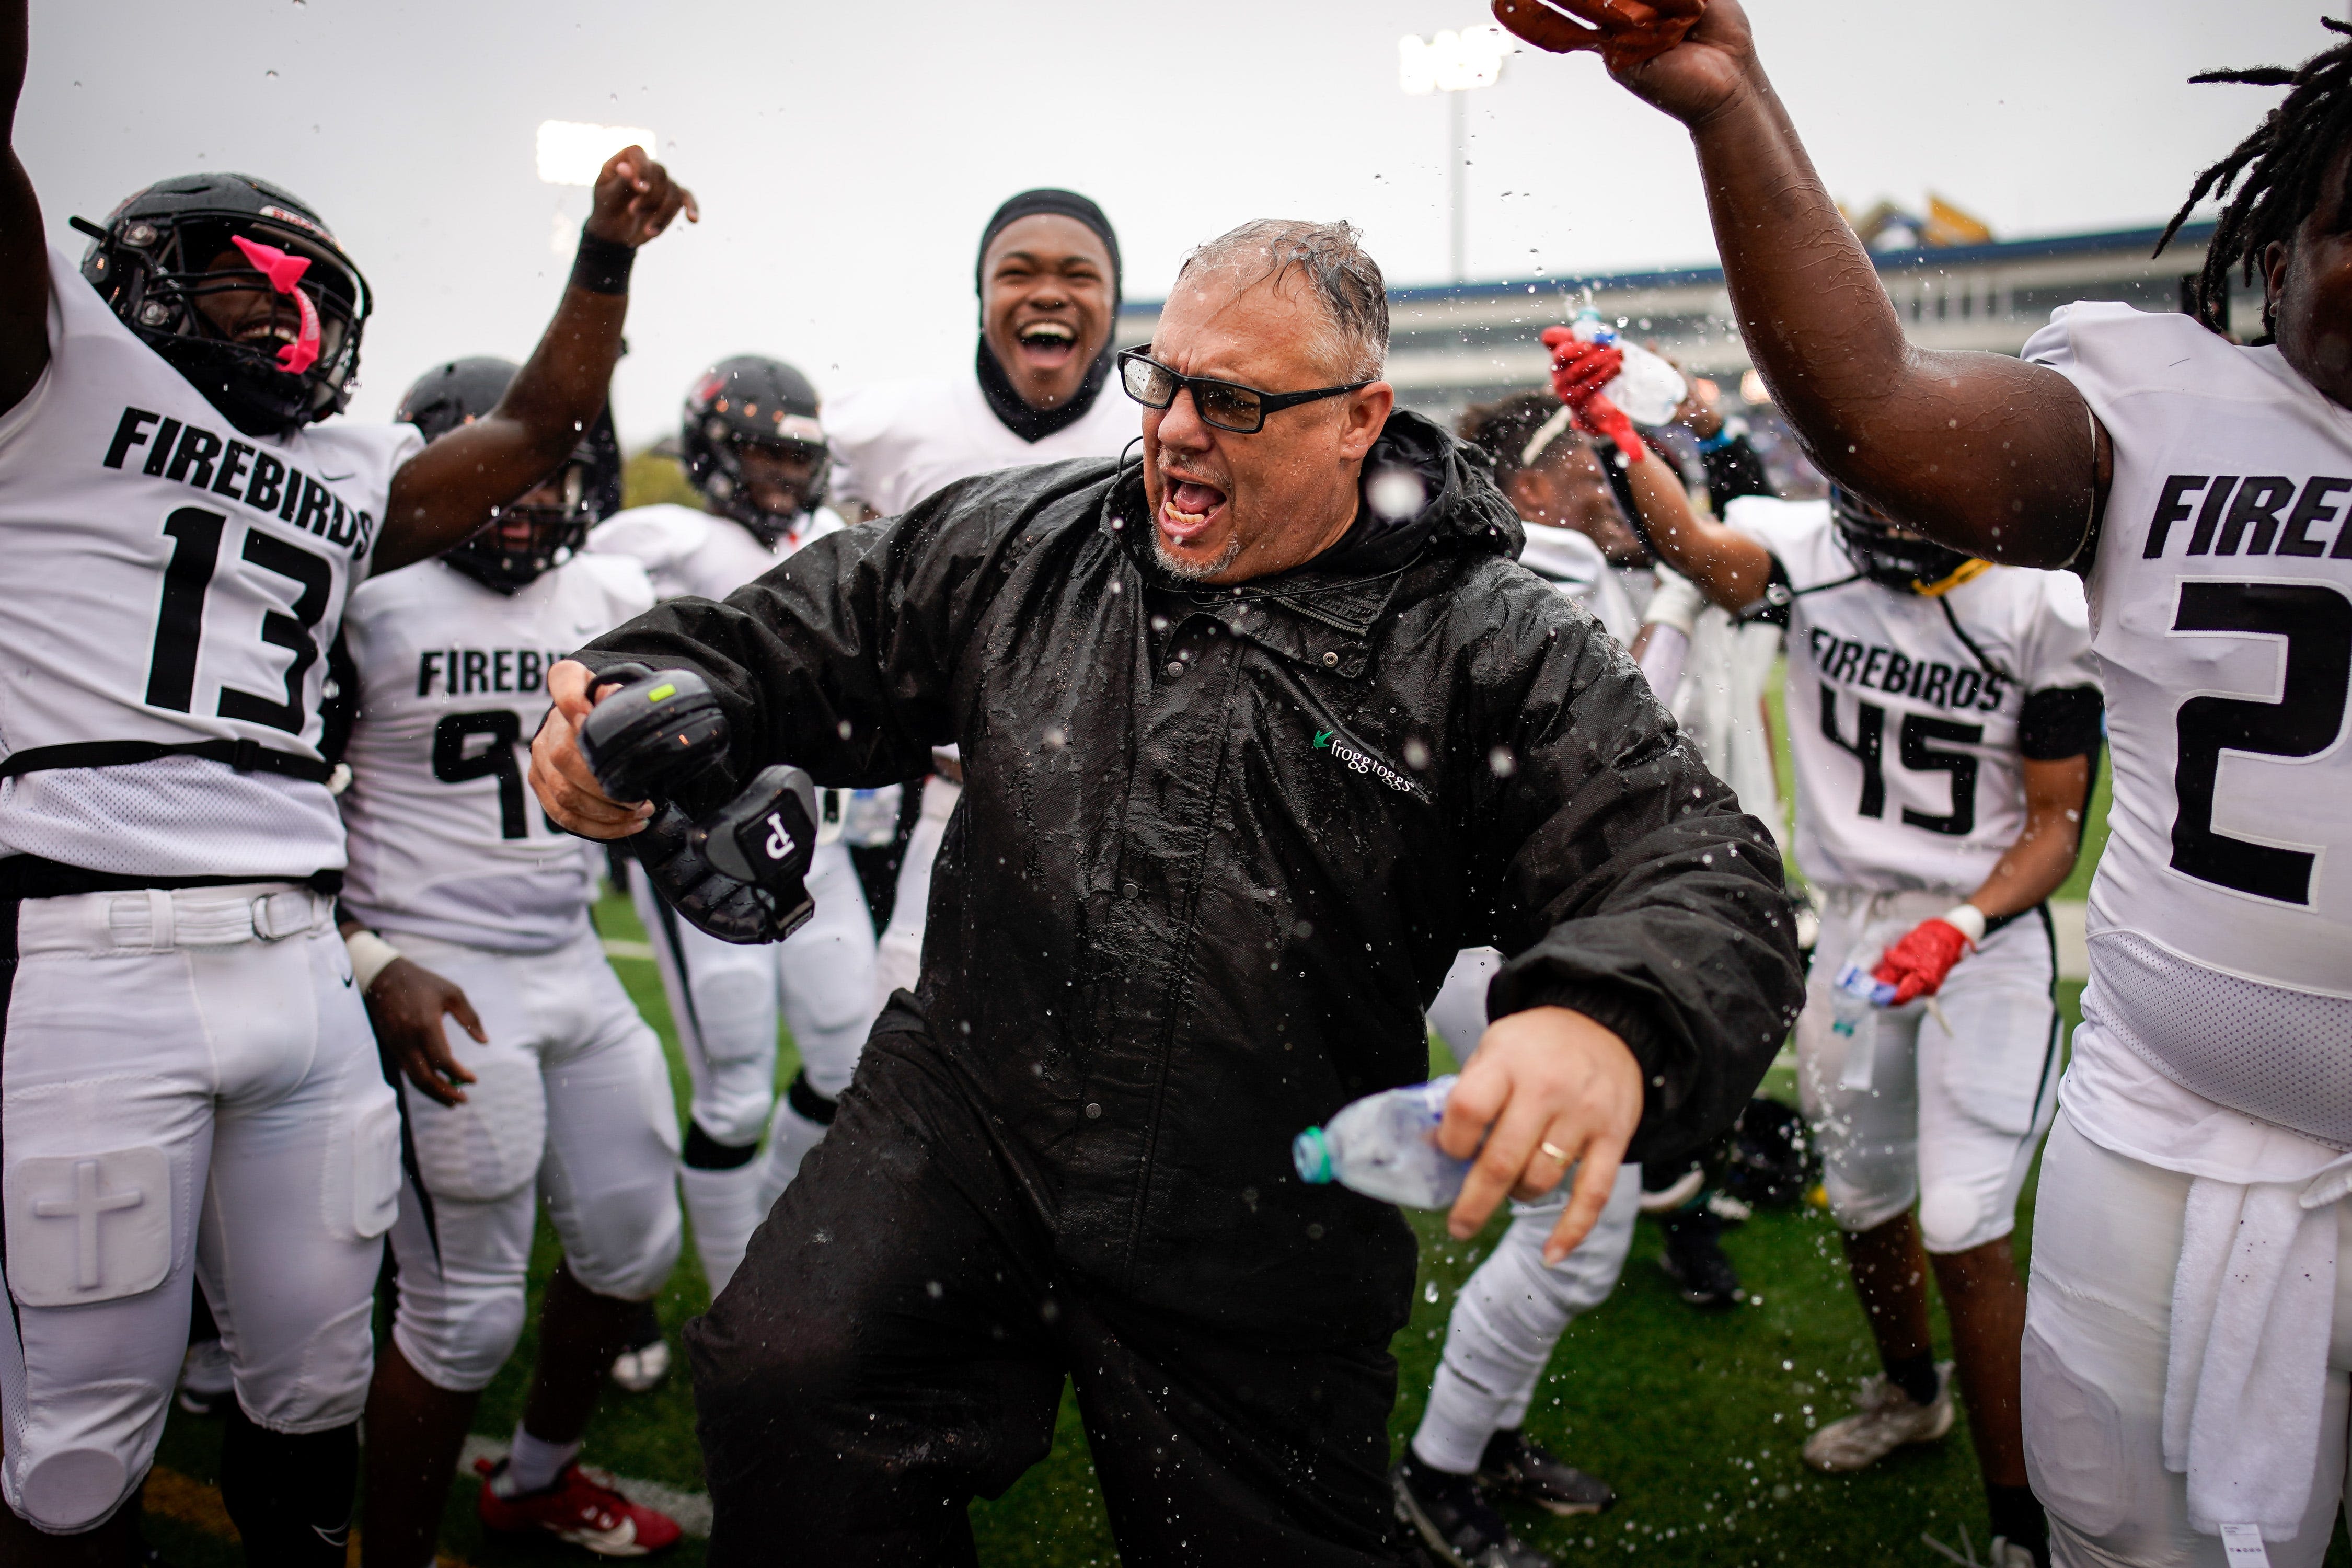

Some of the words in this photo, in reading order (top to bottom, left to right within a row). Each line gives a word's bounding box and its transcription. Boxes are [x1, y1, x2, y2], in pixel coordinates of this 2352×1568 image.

[103, 406, 373, 560] FIREBIRDS
[145, 506, 331, 735] 13
[418, 650, 568, 697] FIREB
[1810, 627, 2006, 711] FIREBIRDS
[432, 710, 564, 840] 9
[1331, 739, 1371, 774] frogg
[1820, 682, 1984, 835] 45
[2169, 581, 2352, 906] 2
